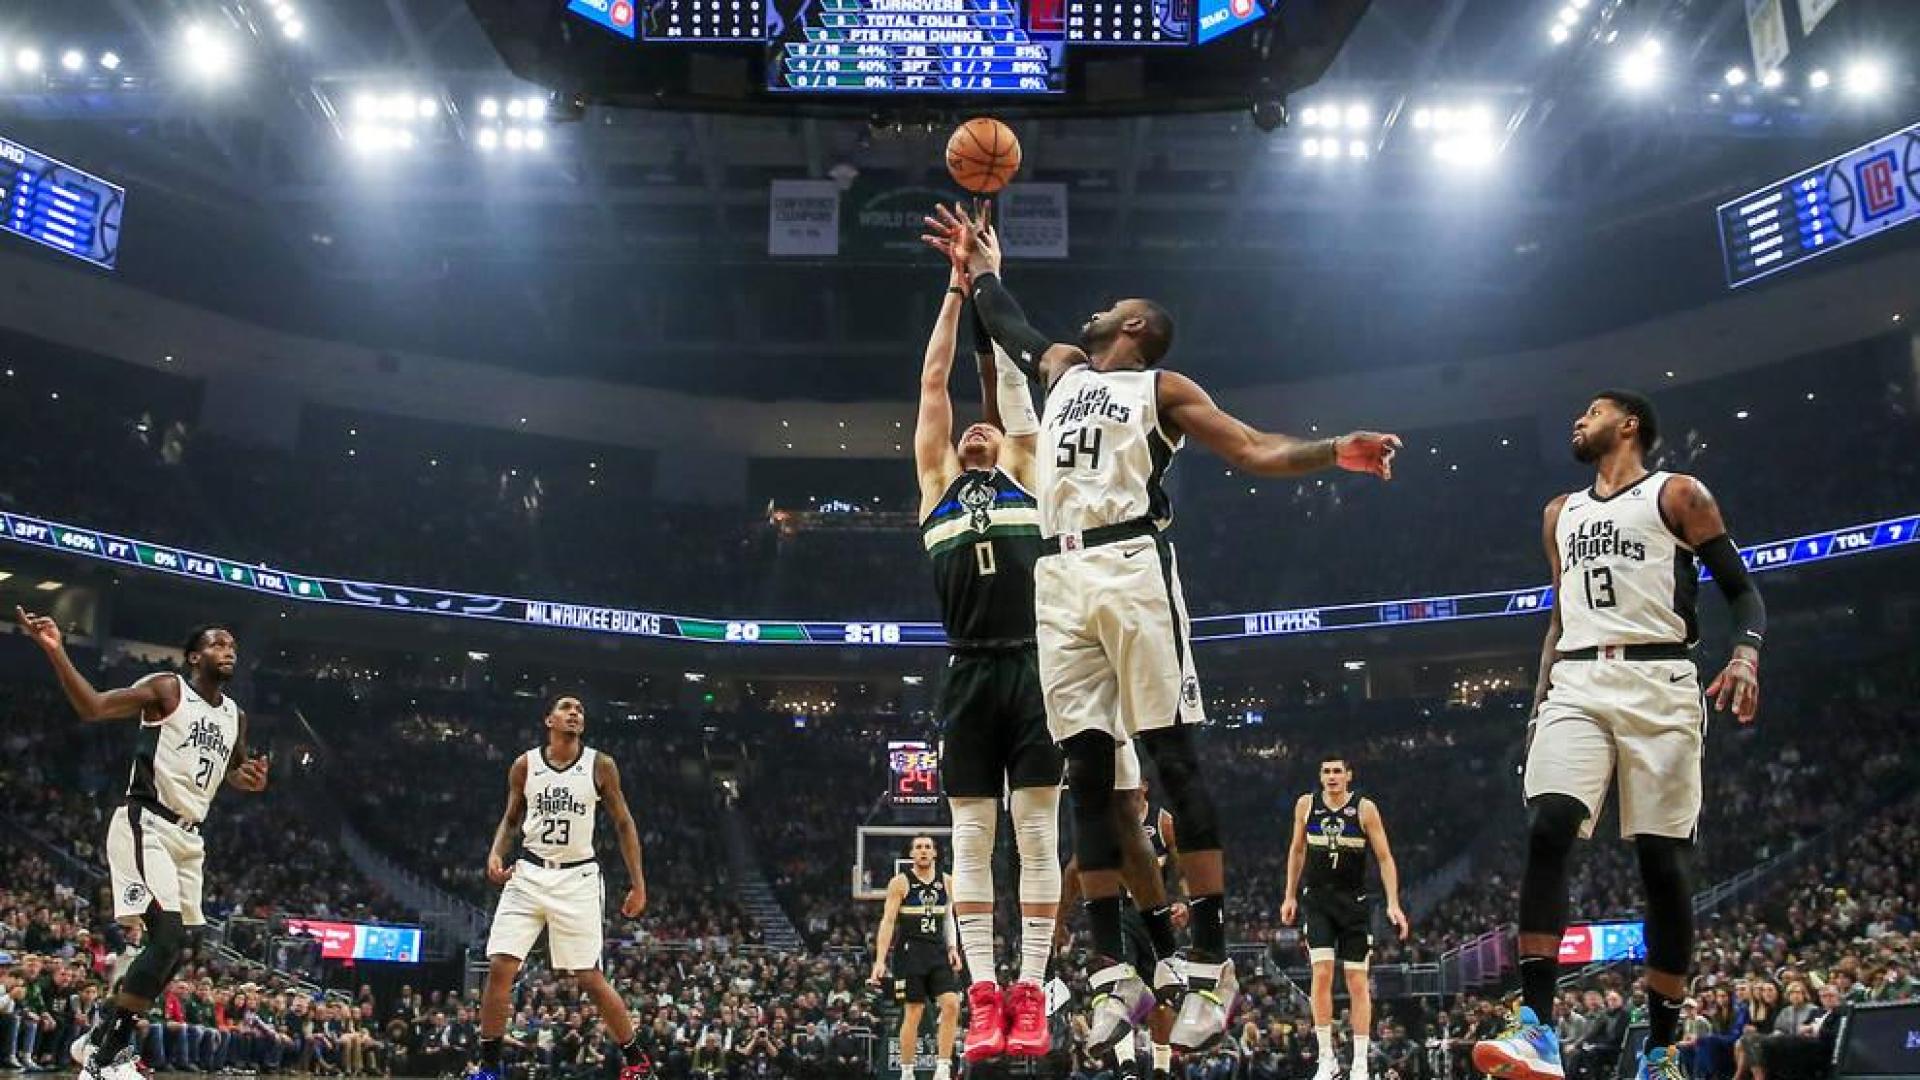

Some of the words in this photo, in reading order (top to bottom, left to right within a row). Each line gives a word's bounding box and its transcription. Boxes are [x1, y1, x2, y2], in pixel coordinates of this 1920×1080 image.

[867, 14, 914, 26] TOTAL
[918, 15, 966, 27] FOULS
[850, 30, 879, 41] PTS
[882, 30, 926, 42] FROM
[930, 30, 982, 42] DUNKS
[798, 60, 807, 71] 4
[857, 60, 887, 71] 40%
[902, 60, 931, 72] 3PT
[798, 75, 807, 87] 0
[864, 75, 887, 87] 0%
[907, 76, 925, 88] FT
[1019, 76, 1041, 88] 0%
[1078, 384, 1109, 404] Los
[1053, 394, 1131, 428] Angeles
[1056, 426, 1102, 470] 54
[1578, 518, 1615, 540] Los
[1807, 541, 1818, 555] 1
[1836, 532, 1870, 550] TOL
[1888, 525, 1903, 540] 7
[15, 522, 48, 541] 3PT
[61, 531, 96, 551] 40%
[108, 543, 128, 558] FT
[154, 552, 178, 567] 0%
[187, 558, 214, 575] FLS
[257, 573, 284, 591] TOL
[975, 540, 996, 576] 0
[1563, 528, 1646, 574] Angeles
[1583, 565, 1617, 610] 13
[526, 601, 610, 630] MILWAUKEE
[612, 609, 661, 635] BUCKS
[1260, 608, 1320, 634] CLIPPERS
[725, 622, 760, 642] 20
[194, 757, 214, 792] 21
[900, 770, 932, 793] 24
[544, 786, 569, 799] Los
[533, 792, 586, 817] Angeles
[541, 819, 571, 845] 23
[1328, 852, 1339, 870] 7
[920, 918, 937, 934] 24
